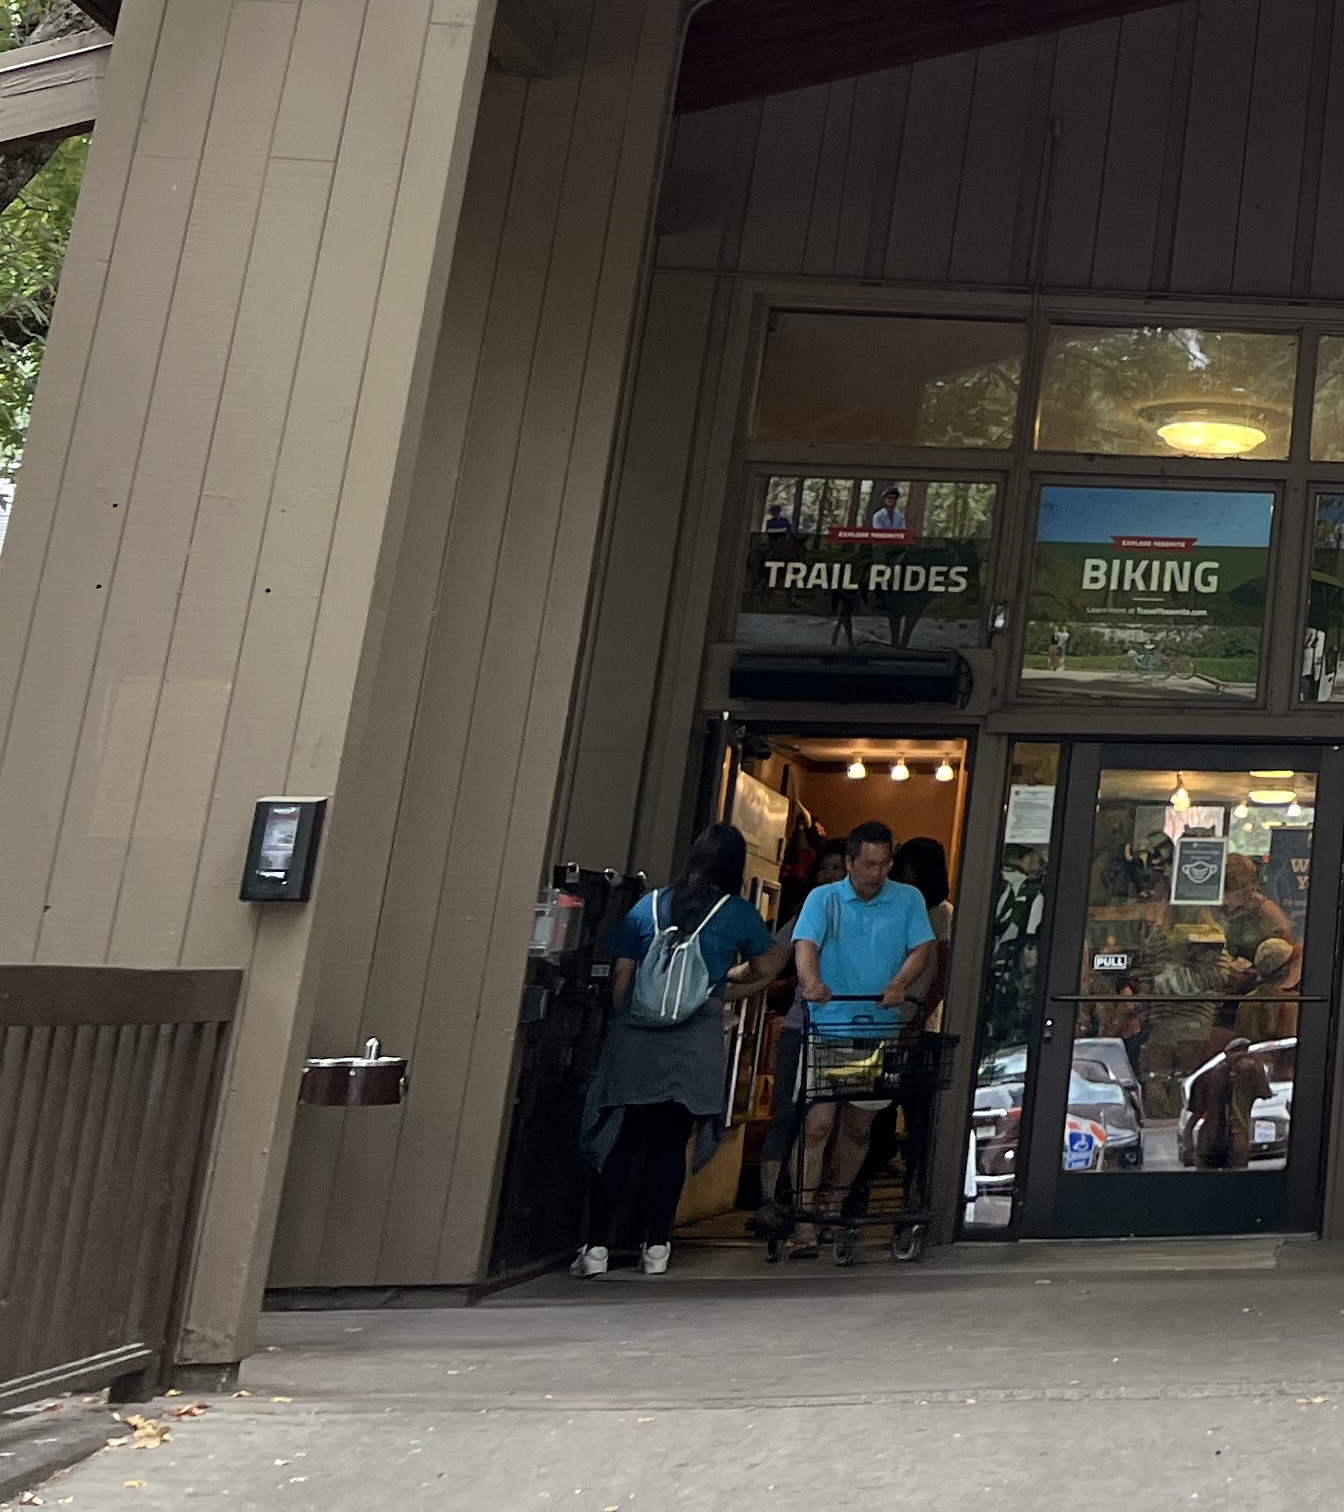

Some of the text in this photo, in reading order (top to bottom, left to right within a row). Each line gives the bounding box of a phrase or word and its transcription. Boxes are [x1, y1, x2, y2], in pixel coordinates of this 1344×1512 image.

[765, 561, 969, 593] TRAIL RIDES
[1082, 558, 1220, 593] BIKING
[1096, 957, 1124, 967] PULL
